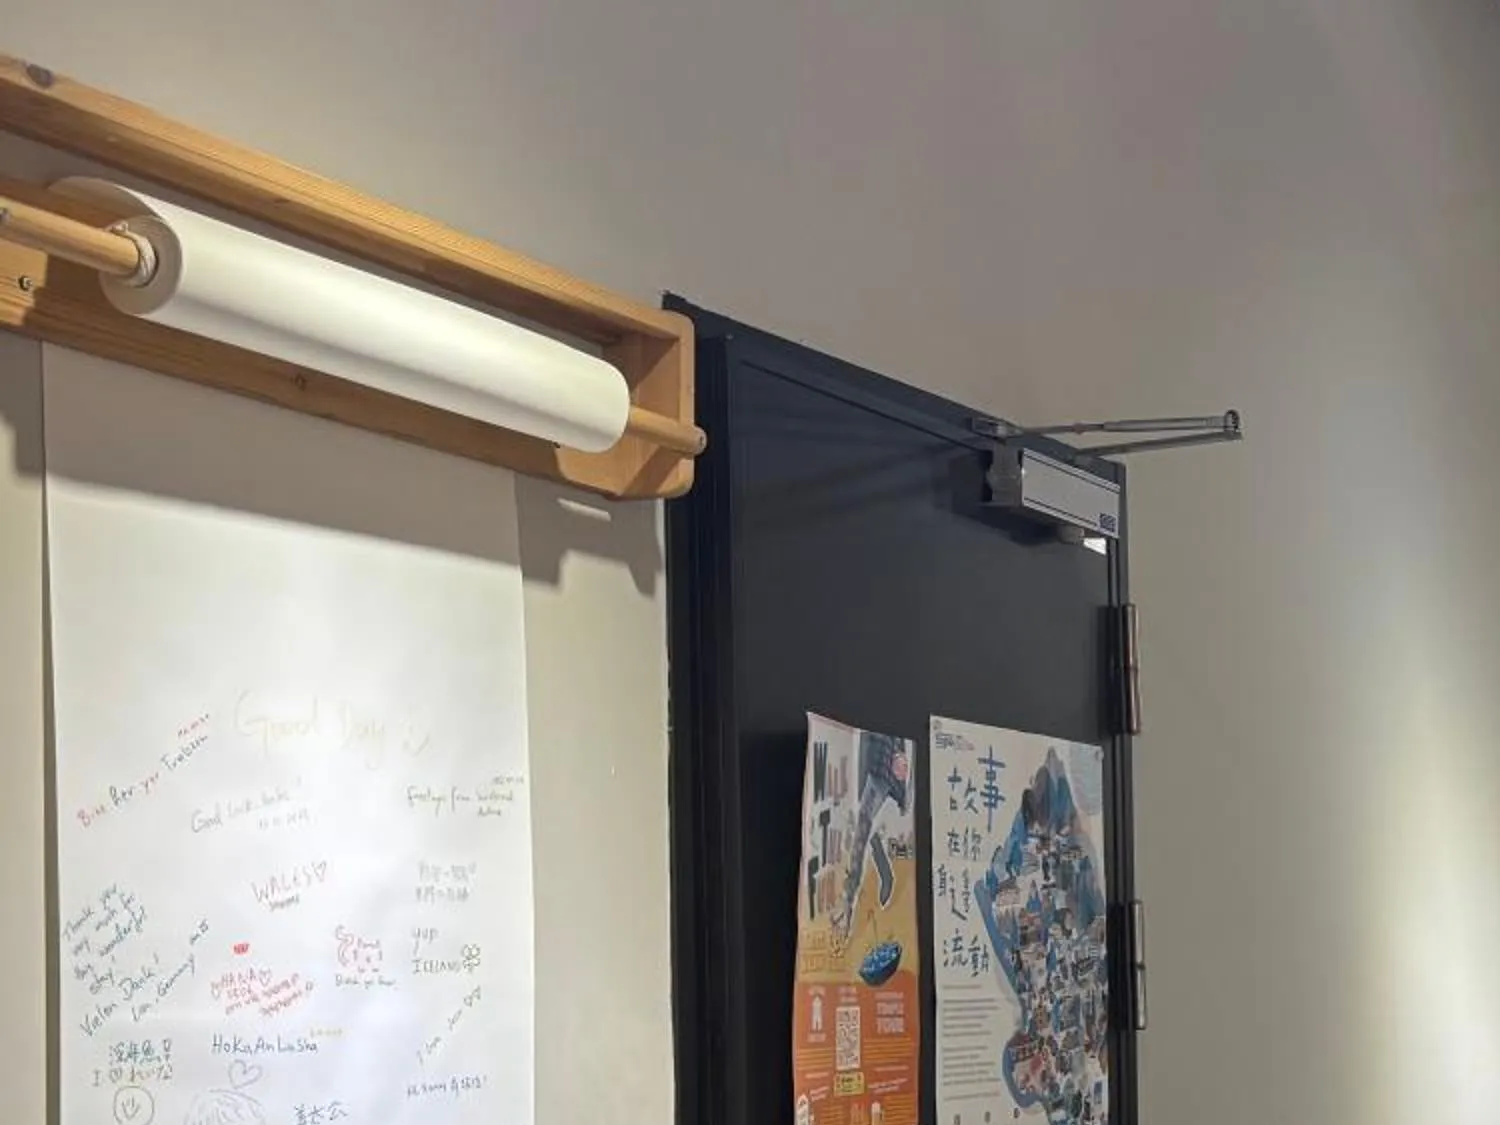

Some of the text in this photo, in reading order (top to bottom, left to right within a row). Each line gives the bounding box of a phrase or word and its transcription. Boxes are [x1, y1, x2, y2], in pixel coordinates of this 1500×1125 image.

[946, 826, 983, 862] 在你
[251, 866, 312, 903] WALES
[942, 927, 990, 979] 流動
